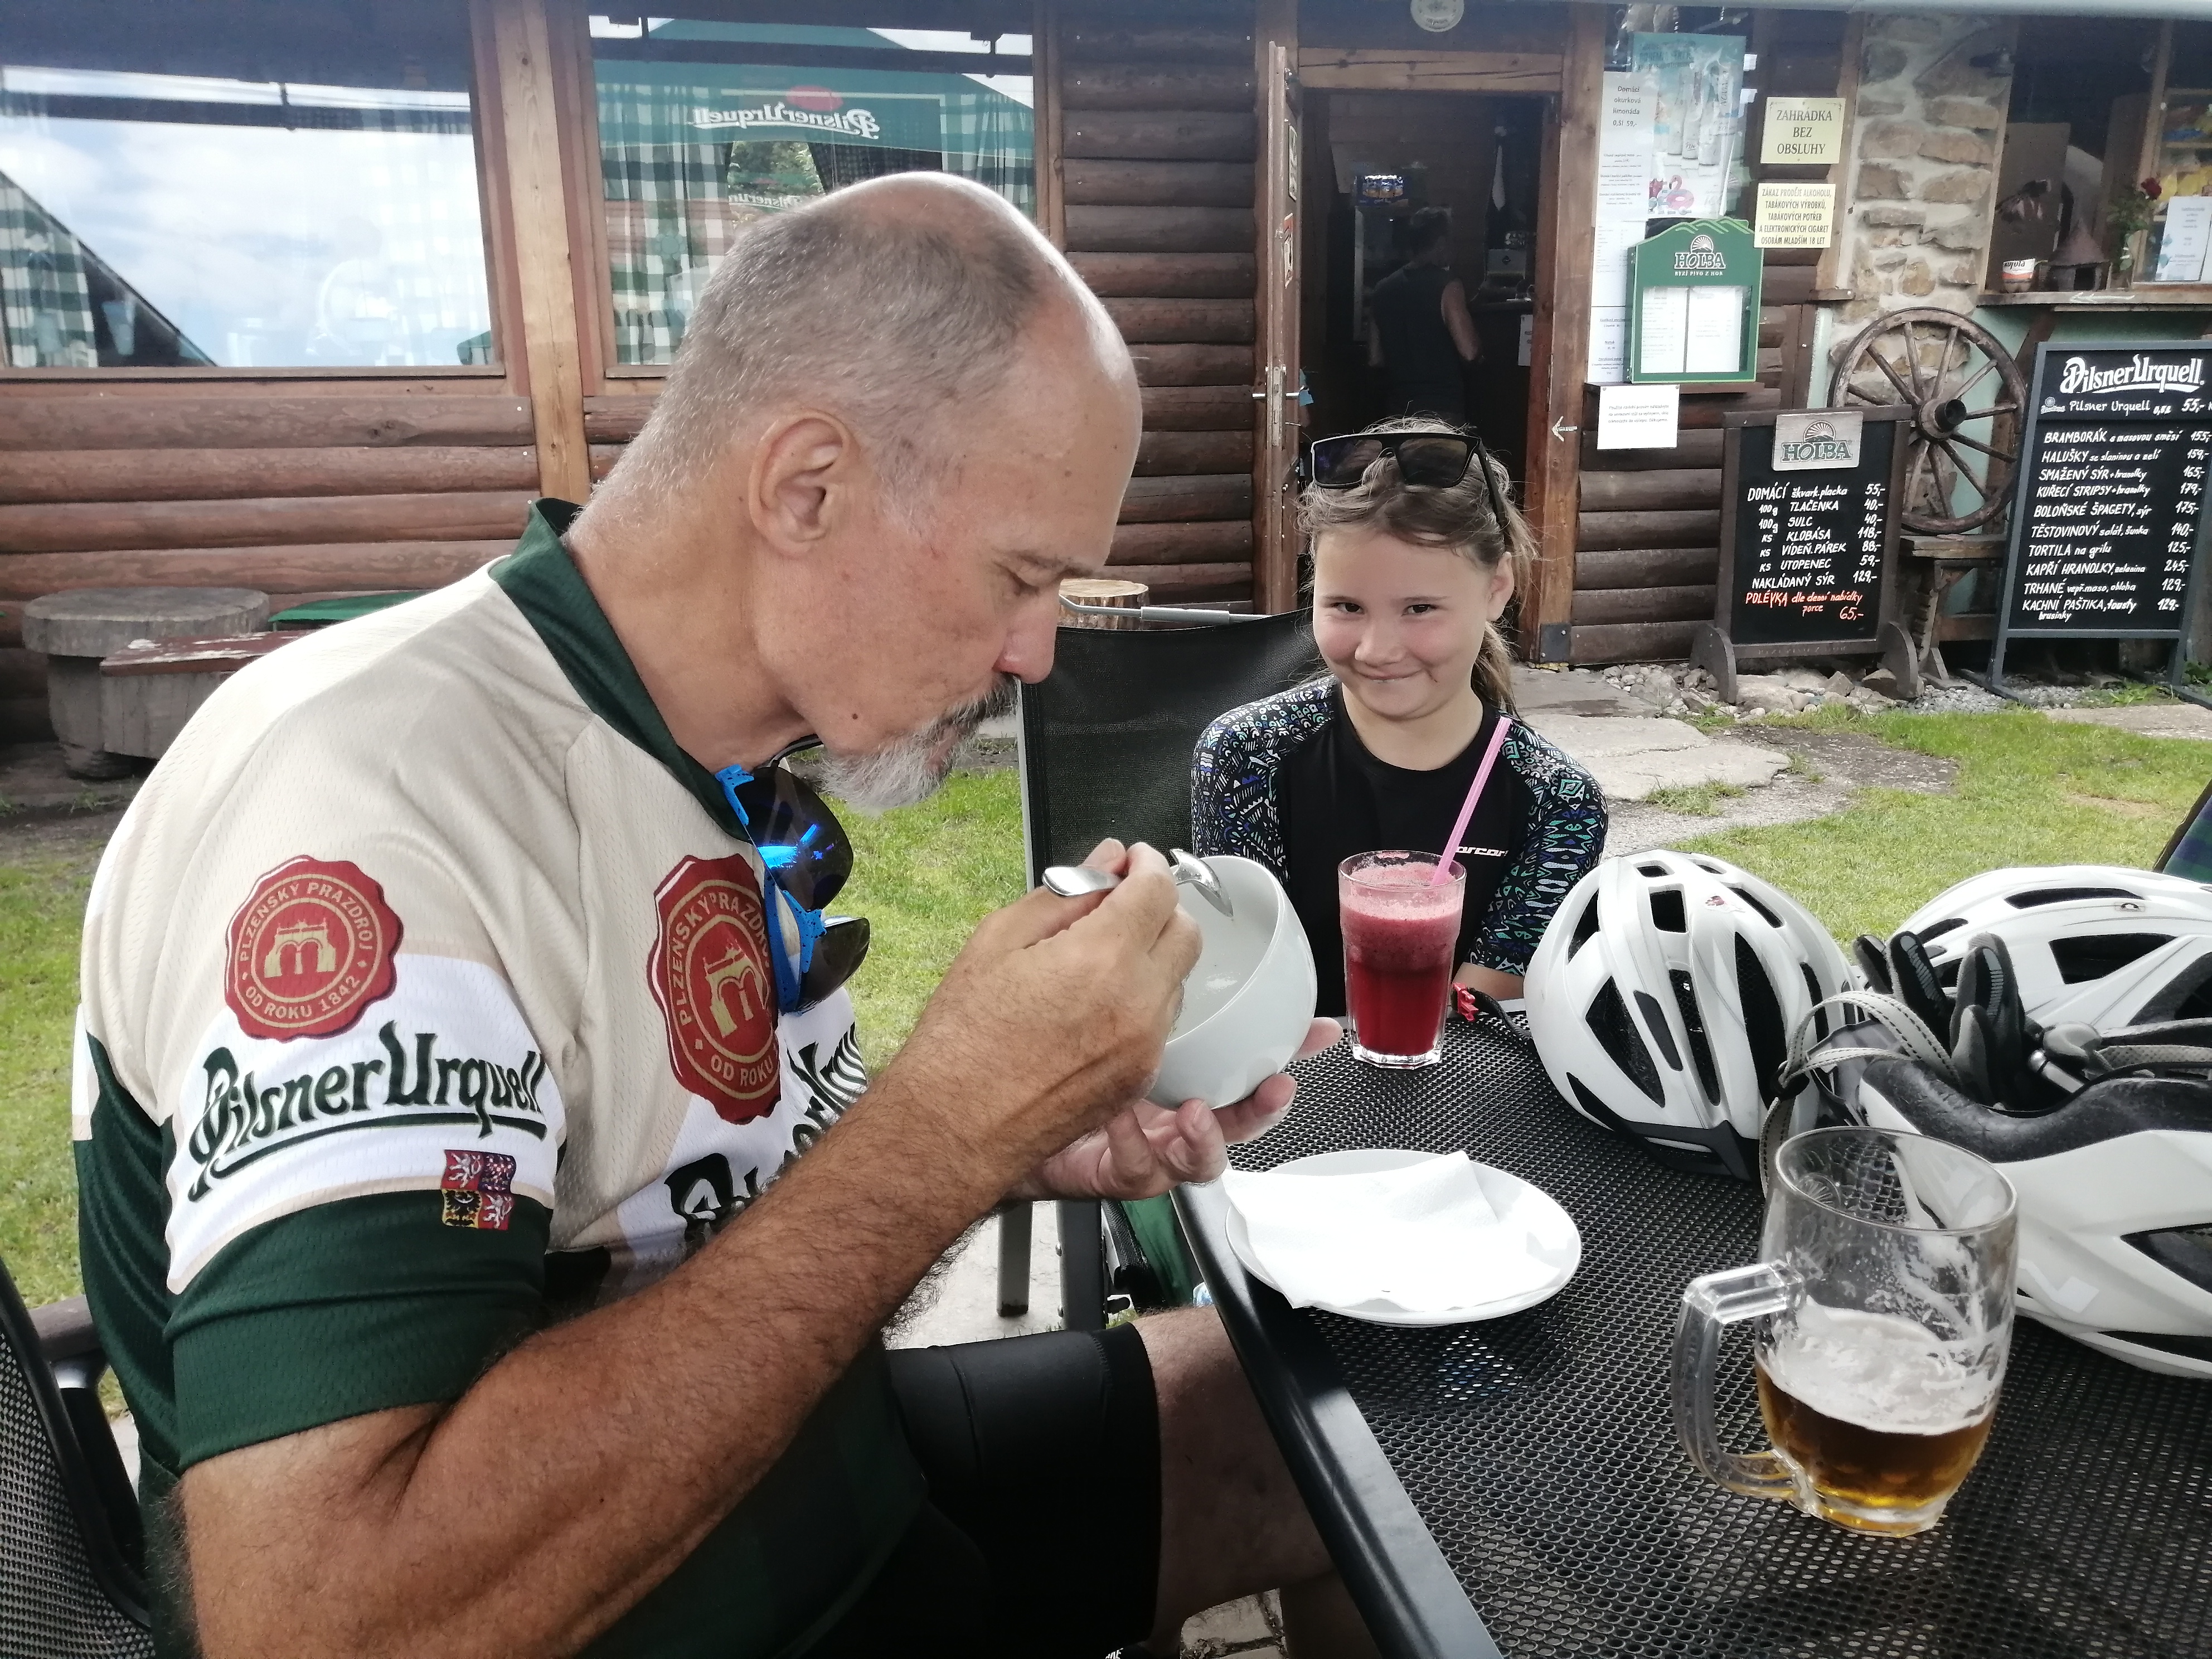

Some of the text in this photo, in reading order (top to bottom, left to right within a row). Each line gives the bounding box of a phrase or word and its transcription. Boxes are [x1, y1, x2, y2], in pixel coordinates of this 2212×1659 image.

[1776, 106, 1833, 122] ZAHRÁDKA
[1792, 126, 1813, 138] BEZ
[1777, 143, 1826, 155] OBSLUHY
[1762, 186, 1780, 197] ZÁKAZ
[1803, 188, 1832, 198] ALKOHOLU,
[1765, 198, 1799, 209] TABÁKOVÝCH
[1768, 211, 1802, 221] TABÁKOVÝCH
[1759, 222, 1829, 233] A ELEKTRONICKÝCH CIGARET
[1783, 235, 1807, 245] MLADŠÍM
[1809, 236, 1816, 245] 18
[1817, 236, 1825, 245] LET
[1673, 252, 1726, 269] HOLBA
[2069, 400, 2108, 412] Pilsner
[2111, 400, 2151, 416] Urquell
[2181, 397, 2206, 414] 55,-
[2044, 427, 2109, 444] BRAMBORÁK
[2117, 433, 2152, 442] masovou
[2154, 430, 2184, 442] směsí
[1781, 440, 1853, 463] HOLBA
[2041, 448, 2089, 463] HALUŠKY
[2100, 450, 2133, 461] slaninou
[2142, 448, 2162, 460] zelí
[2187, 448, 2210, 461] 159,-
[2038, 465, 2089, 482] SMAŽENÝ
[2090, 465, 2109, 481] SÝR
[2182, 465, 2206, 480] 165,-
[1747, 481, 1791, 502] DOMÁCÍ
[1865, 483, 1886, 497] 55,-
[2036, 483, 2074, 498] KUŘECÍ
[2073, 486, 2112, 498] STRIPSY
[2179, 482, 2203, 497] 179,-
[1789, 499, 1839, 512] TLAČENKA
[1864, 498, 1885, 511] 40,-
[2033, 501, 2089, 518] BOLOŇSKÉ
[2175, 501, 2199, 516] 175,-
[1787, 516, 1813, 527] SULC
[1864, 513, 1883, 527] 40,-
[1761, 526, 1882, 543] KS KLOBÁSA 118,-
[2030, 520, 2101, 539] TĚSTOVINOVÝ
[2124, 525, 2149, 536] šunka
[2171, 522, 2195, 537] 140,-
[1759, 549, 1771, 557] KS
[1861, 540, 1881, 552] 88,-
[2028, 541, 2192, 559] TORTILA na grilu 125,-
[1759, 555, 1880, 573] KS UTOPENEC 59,-
[2025, 559, 2061, 576] KAPŘÍ
[2164, 559, 2190, 574] 245,-
[1752, 570, 1878, 589] NAKLÁDANÝ SÝR 129,-
[2024, 578, 2068, 595] TRHANÉ
[2110, 581, 2137, 591] obloha
[2161, 578, 2186, 592] 129,-
[1745, 589, 1788, 608] POLÉVKA
[1791, 591, 1806, 604] dle
[1830, 589, 1863, 606] nabídky
[2022, 594, 2063, 611] KACHNÍ
[2157, 598, 2180, 611] 129,-
[1802, 604, 1864, 621] porce 65,-
[2038, 610, 2073, 623] brusinky
[306, 881, 374, 950] PRAZDROJ
[245, 974, 361, 1020] OD ROKU 1842
[710, 1054, 774, 1086] OD ROKU
